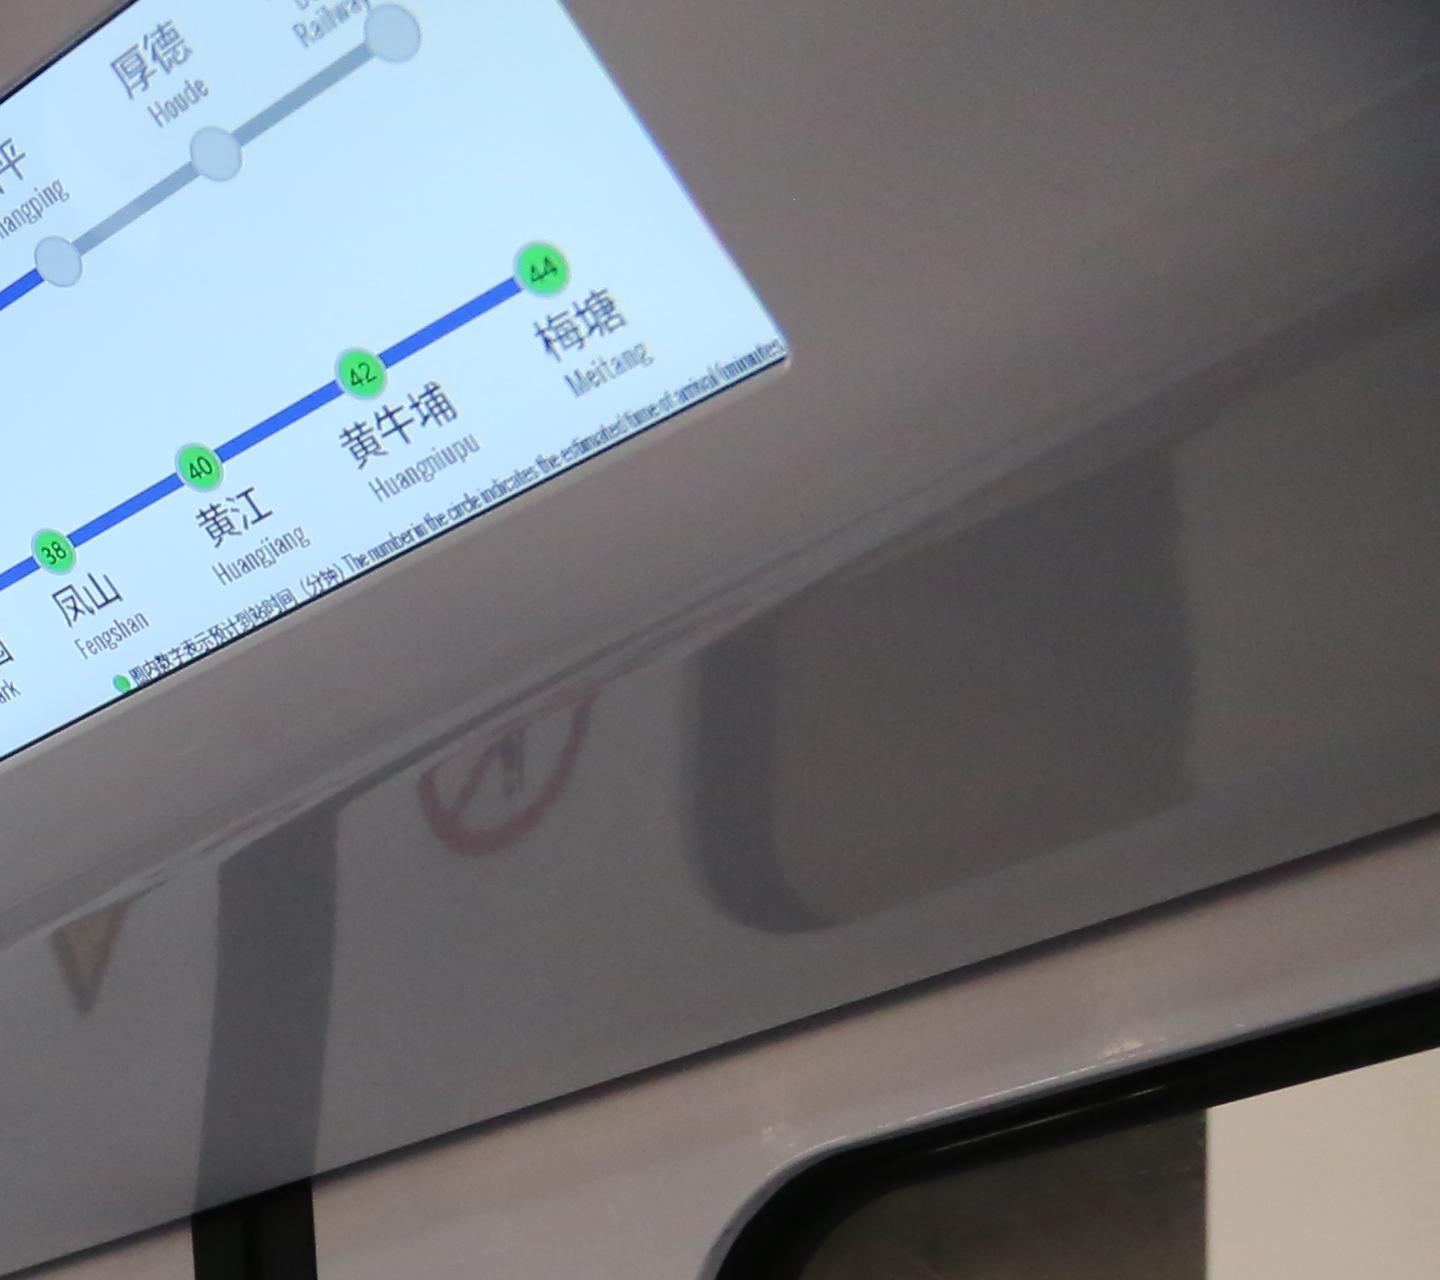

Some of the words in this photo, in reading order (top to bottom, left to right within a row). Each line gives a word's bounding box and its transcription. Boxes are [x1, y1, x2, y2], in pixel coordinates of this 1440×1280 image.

[109, 18, 193, 99] 厚德
[147, 76, 210, 128] Houde
[529, 256, 558, 283] 44
[532, 287, 629, 362] 梅塘
[349, 361, 377, 387] 42
[564, 343, 655, 397] Meitang
[338, 379, 459, 470] 黄牛埔
[188, 456, 214, 480] 40
[368, 433, 482, 503] Huangniupu
[194, 486, 275, 549] 黄江
[41, 540, 67, 565] 38
[212, 522, 312, 586] Huangjiang
[367, 526, 418, 564] number
[51, 571, 125, 628] 凤山
[74, 609, 150, 660] Fengshan
